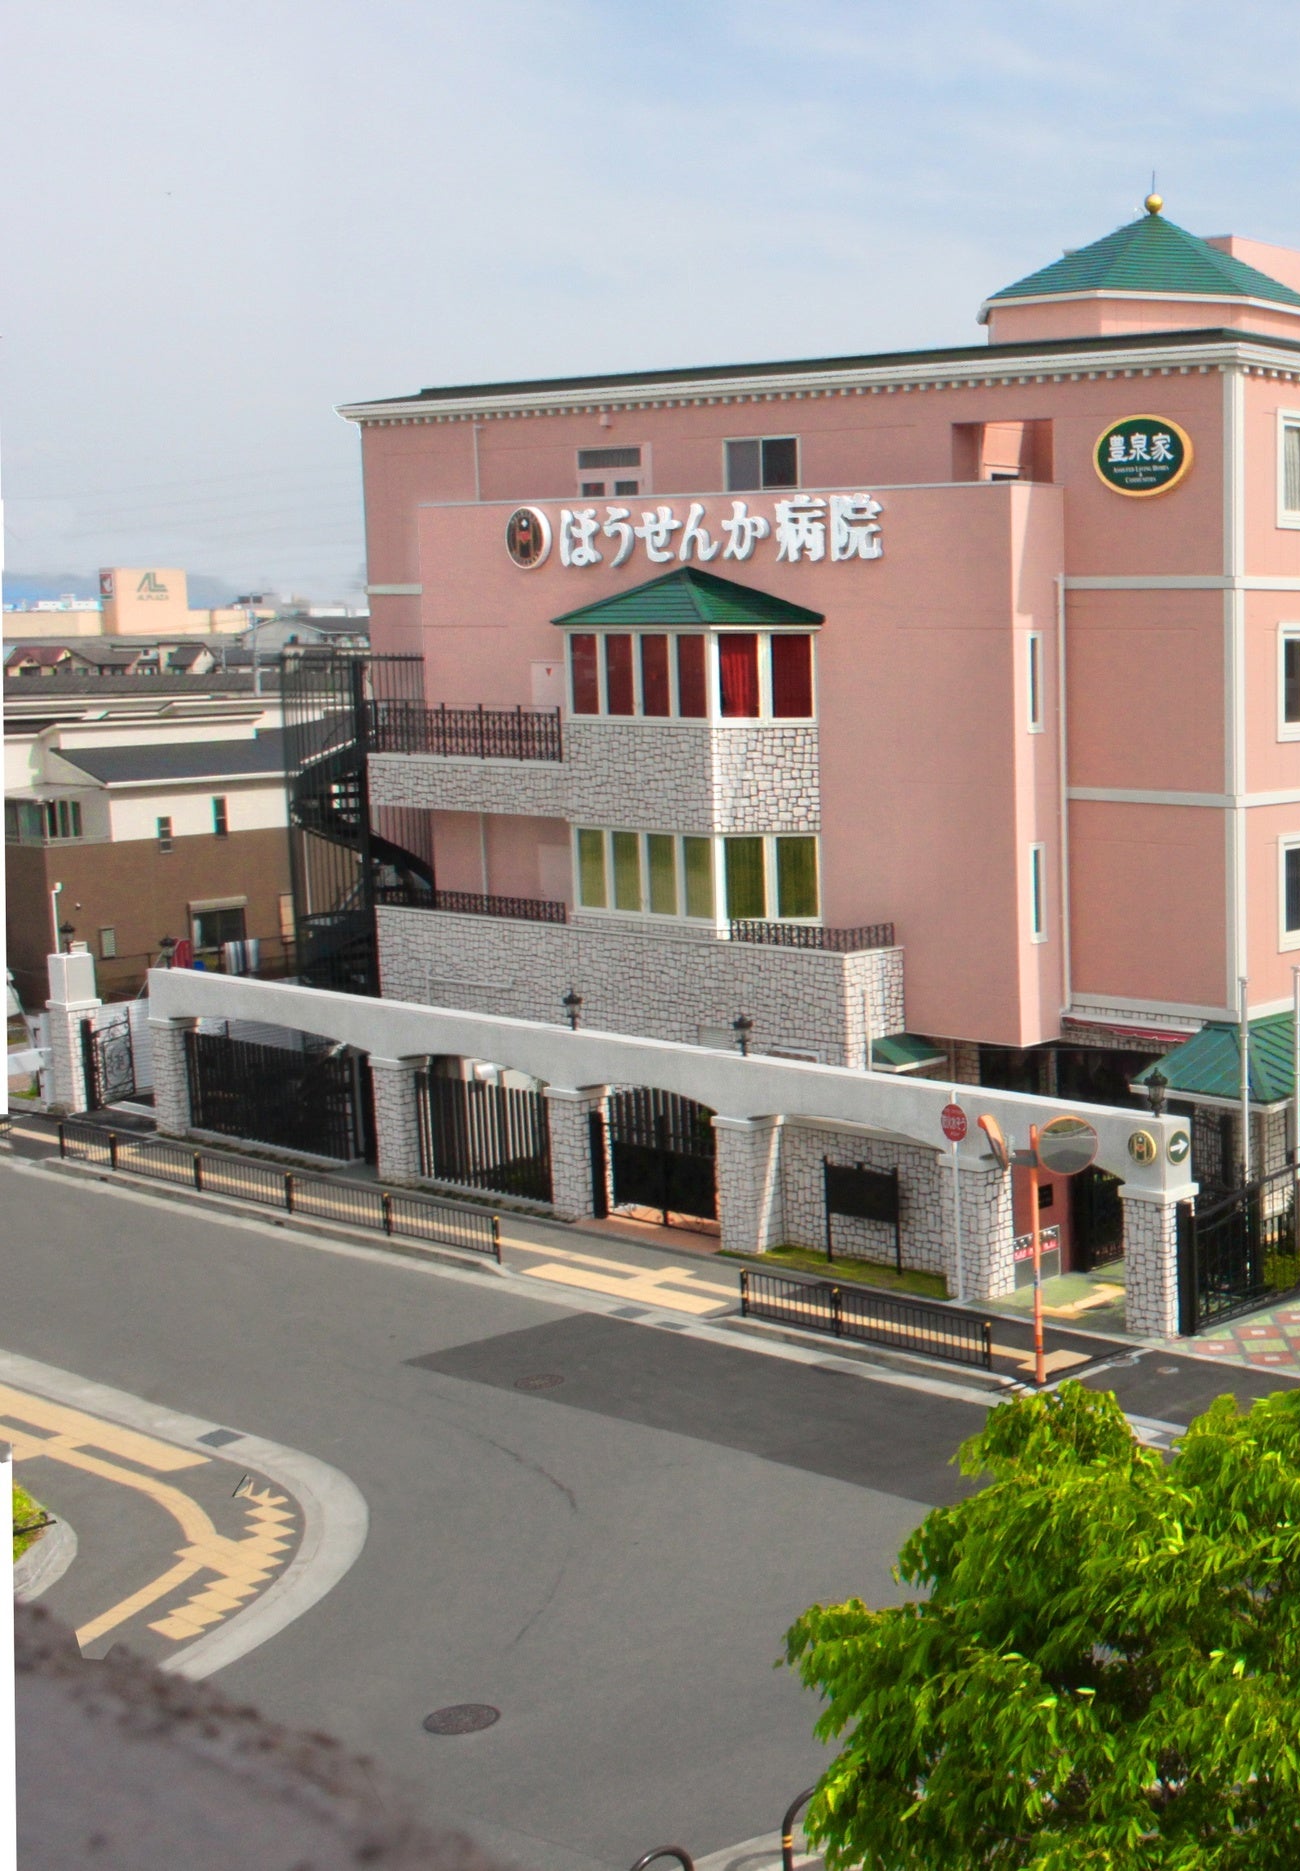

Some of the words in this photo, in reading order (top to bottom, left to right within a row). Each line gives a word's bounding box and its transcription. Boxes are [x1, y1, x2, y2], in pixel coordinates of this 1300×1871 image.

[559, 493, 884, 568] ほうせんか病院
